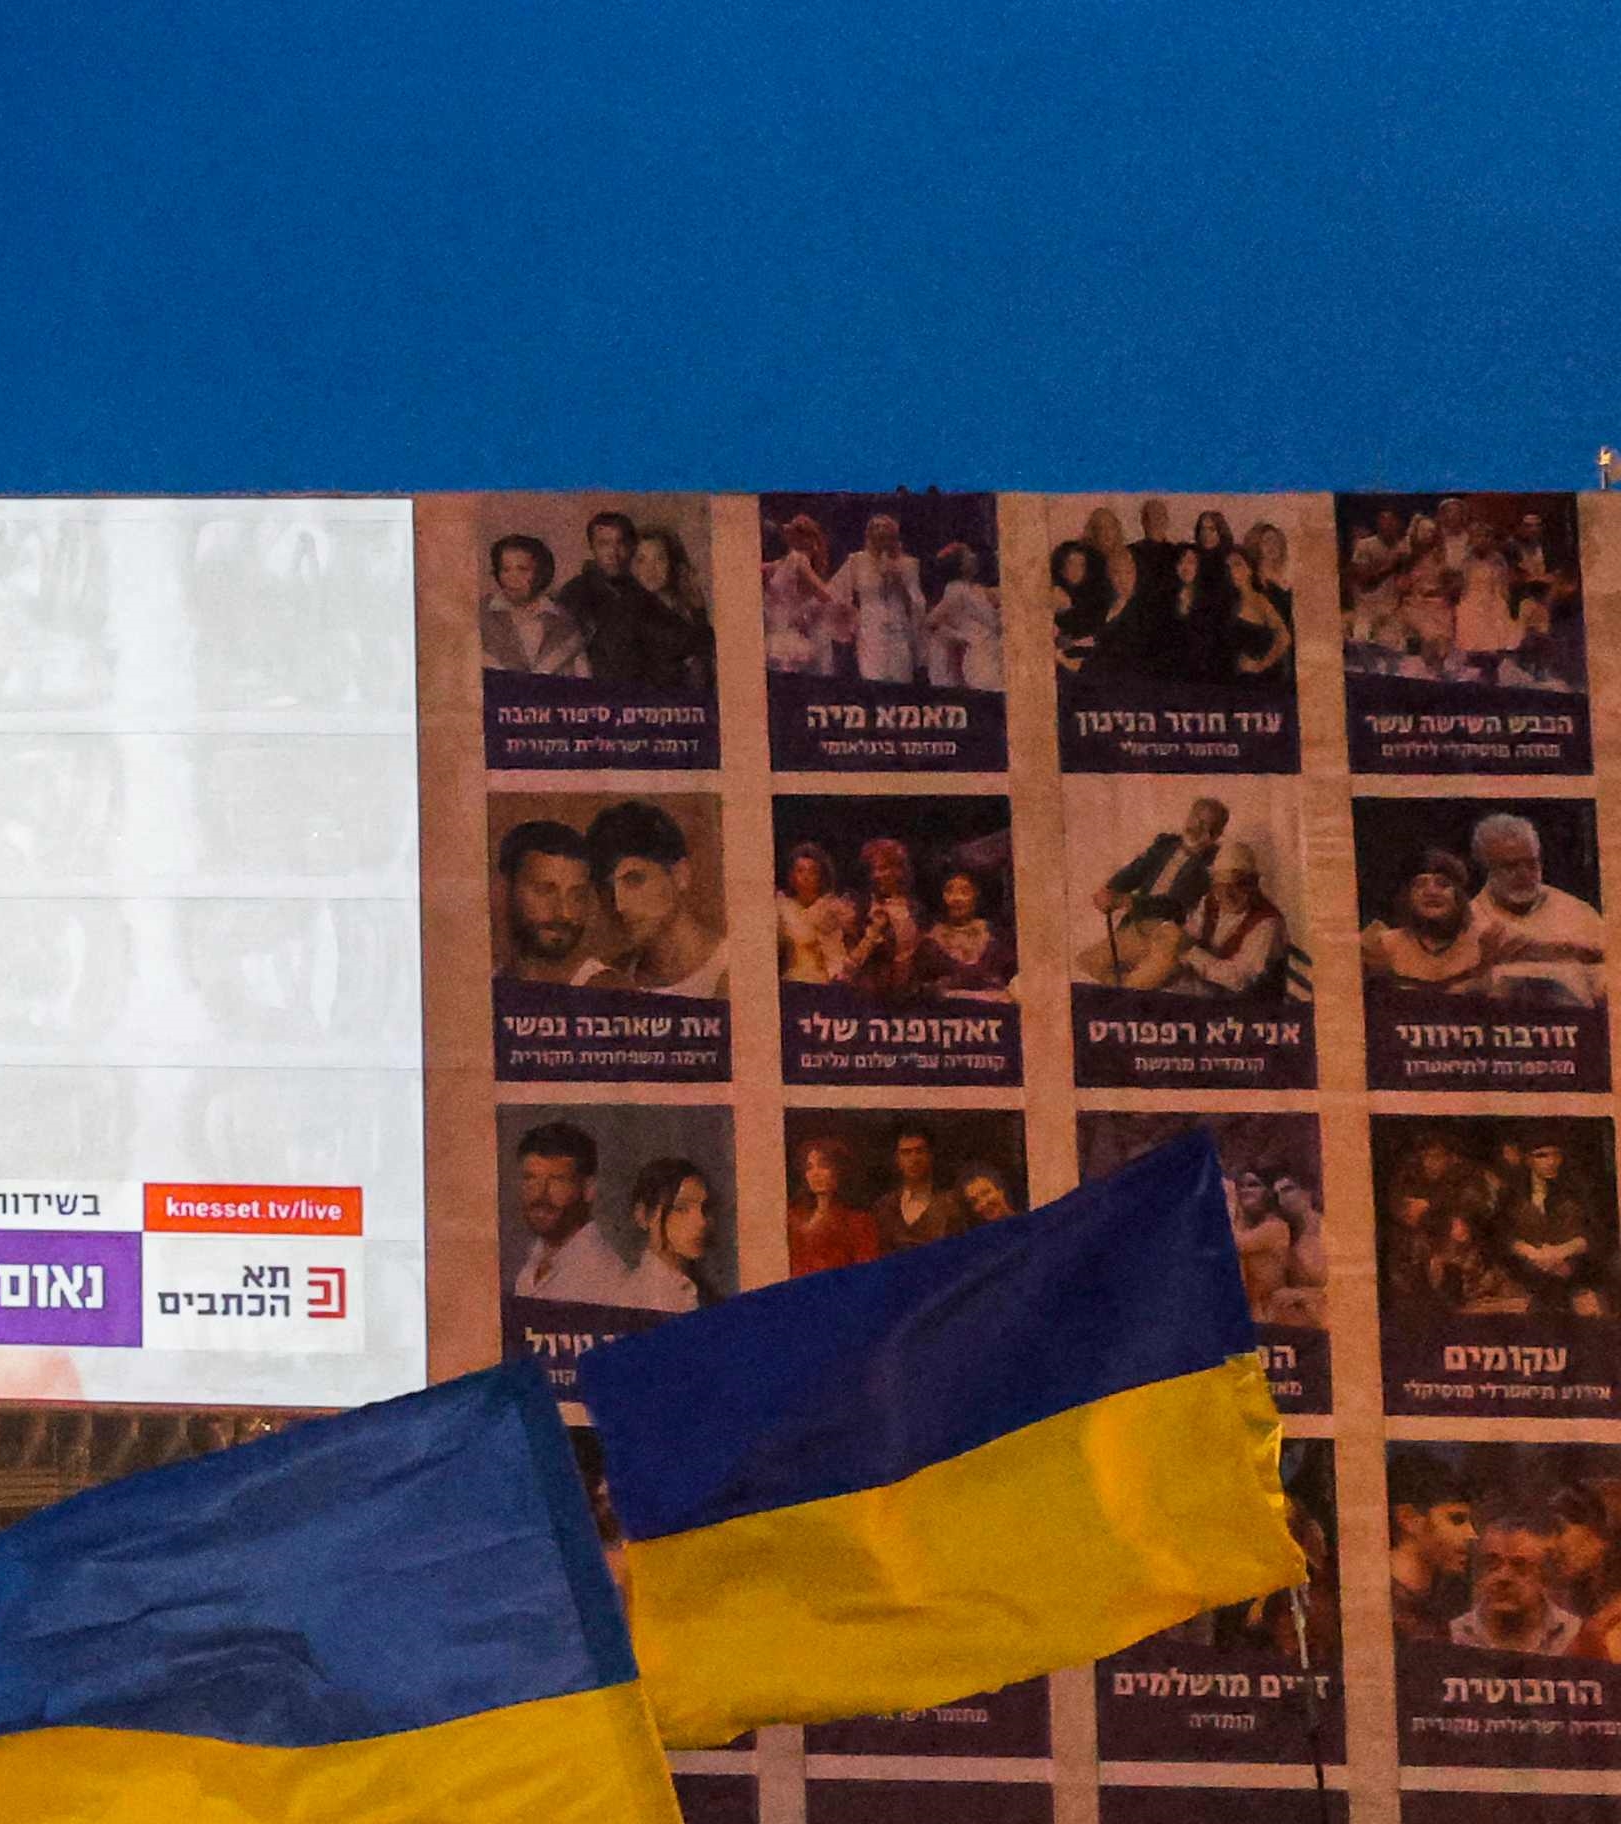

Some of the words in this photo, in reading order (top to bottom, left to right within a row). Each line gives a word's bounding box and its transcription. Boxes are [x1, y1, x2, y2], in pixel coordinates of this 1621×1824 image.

[498, 706, 551, 724] אהבה
[557, 706, 611, 724] סיפור
[806, 704, 866, 729] מיה
[876, 704, 968, 729] מאמא
[1074, 711, 1157, 737] הניגון
[1163, 711, 1227, 733] חוזר
[1232, 711, 1283, 733] עוד
[1364, 713, 1414, 734] עשר
[1419, 715, 1502, 734] השישה
[1508, 714, 1574, 735] הכבש
[505, 738, 570, 755] מקורית
[573, 736, 649, 753] ישראלית
[653, 738, 700, 753] דרמה
[502, 1015, 568, 1038] נפשי
[575, 1015, 673, 1038] שאהבה
[679, 1015, 722, 1038] את
[797, 1011, 860, 1043] שלי
[868, 1017, 1003, 1049] זאקופנה
[1088, 1019, 1198, 1044] רפפורט
[1206, 1016, 1244, 1045] לא
[1251, 1022, 1301, 1045] אני
[1394, 1024, 1484, 1048] היווני
[1492, 1024, 1580, 1048] זורבה
[509, 1049, 575, 1068] מקורית
[579, 1050, 666, 1066] משפחתית
[670, 1050, 718, 1065] דרמה
[800, 1052, 850, 1069] עליכם
[854, 1052, 898, 1069] שלום
[241, 1264, 291, 1289] תא
[158, 1290, 291, 1318] הכתבים
[1443, 1345, 1568, 1377] עקומים
[1113, 1667, 1251, 1698] מושלמים
[1442, 1677, 1603, 1706] הרובוטית
[1188, 1712, 1256, 1732] קומדיה
[1569, 1719, 1621, 1736] ומדיה
